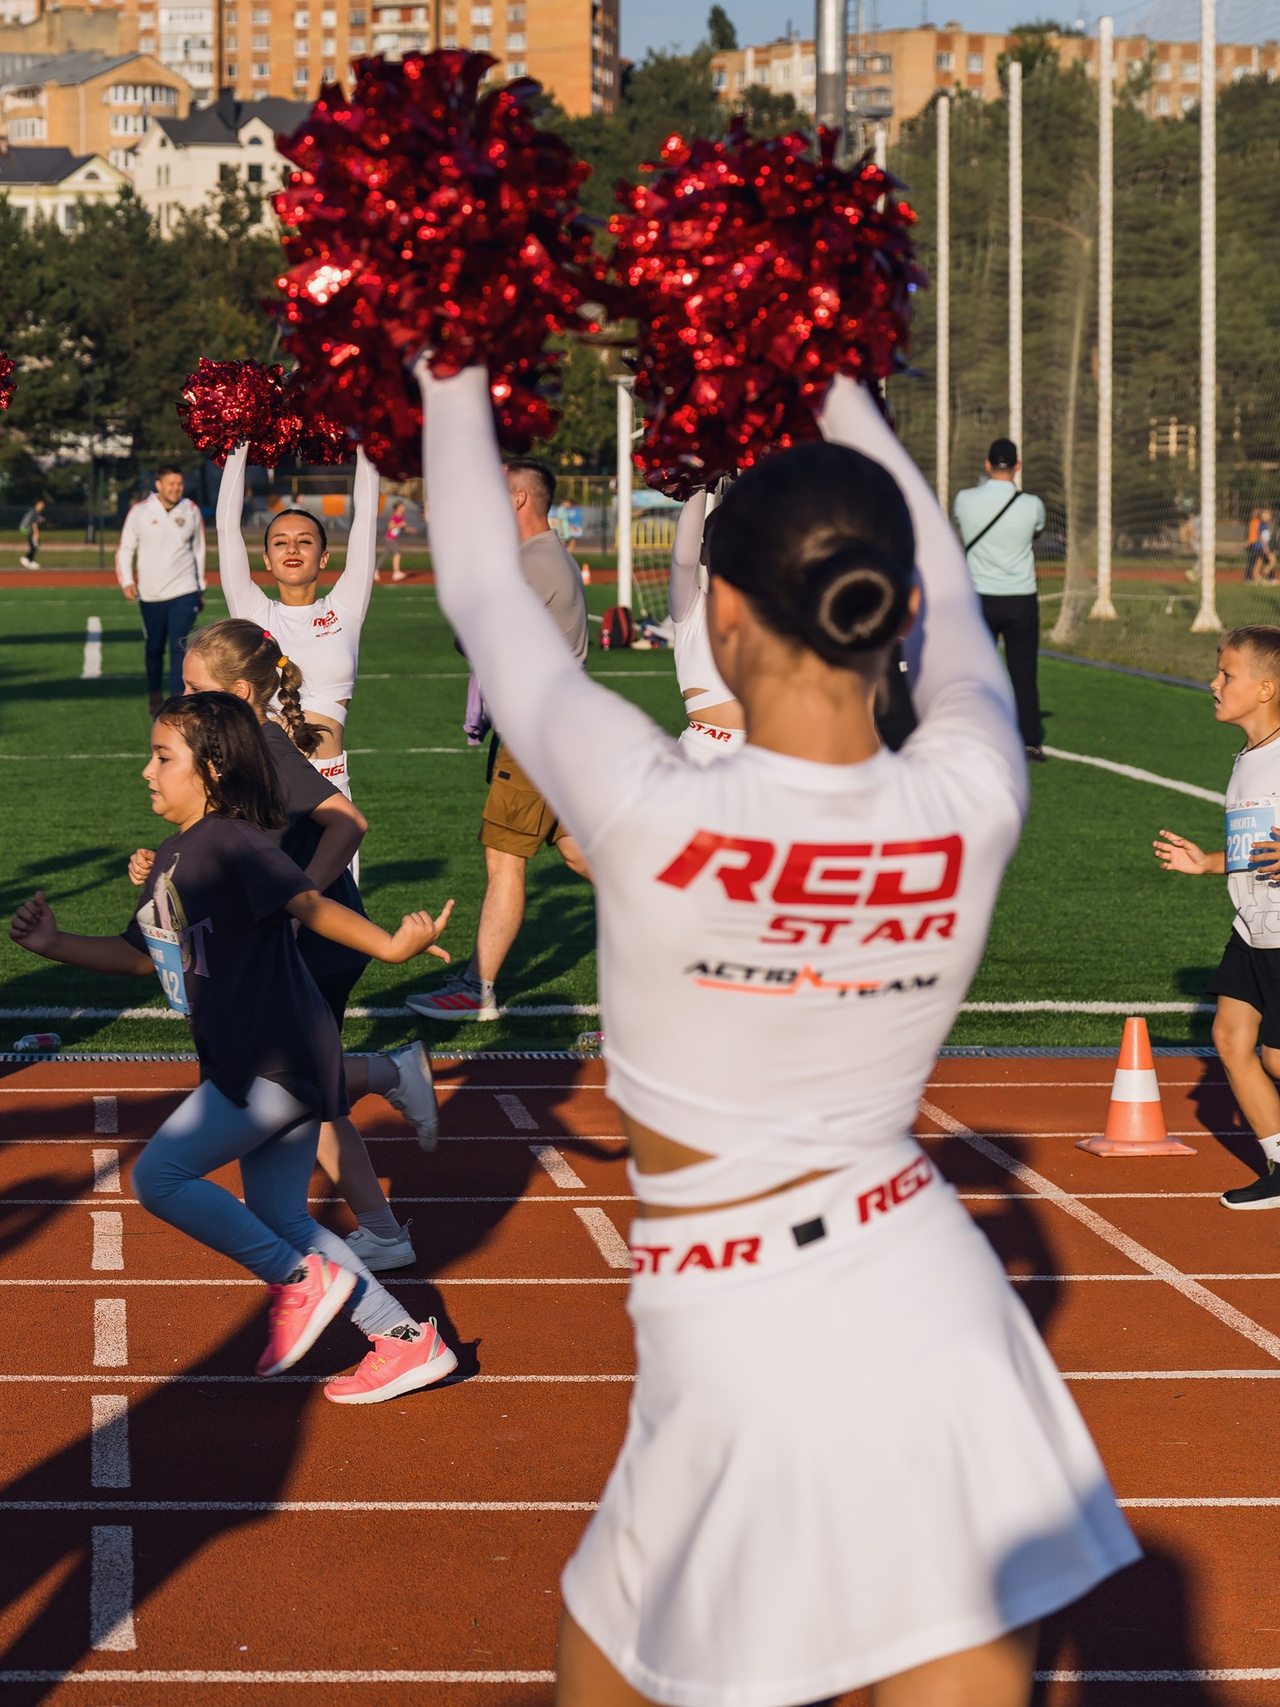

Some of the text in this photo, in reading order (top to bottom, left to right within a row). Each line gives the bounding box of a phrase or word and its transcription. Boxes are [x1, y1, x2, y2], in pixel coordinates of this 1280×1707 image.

[689, 721, 732, 742] STAR
[654, 828, 964, 907] RED
[758, 911, 957, 945] STAR
[857, 1155, 934, 1226] RED
